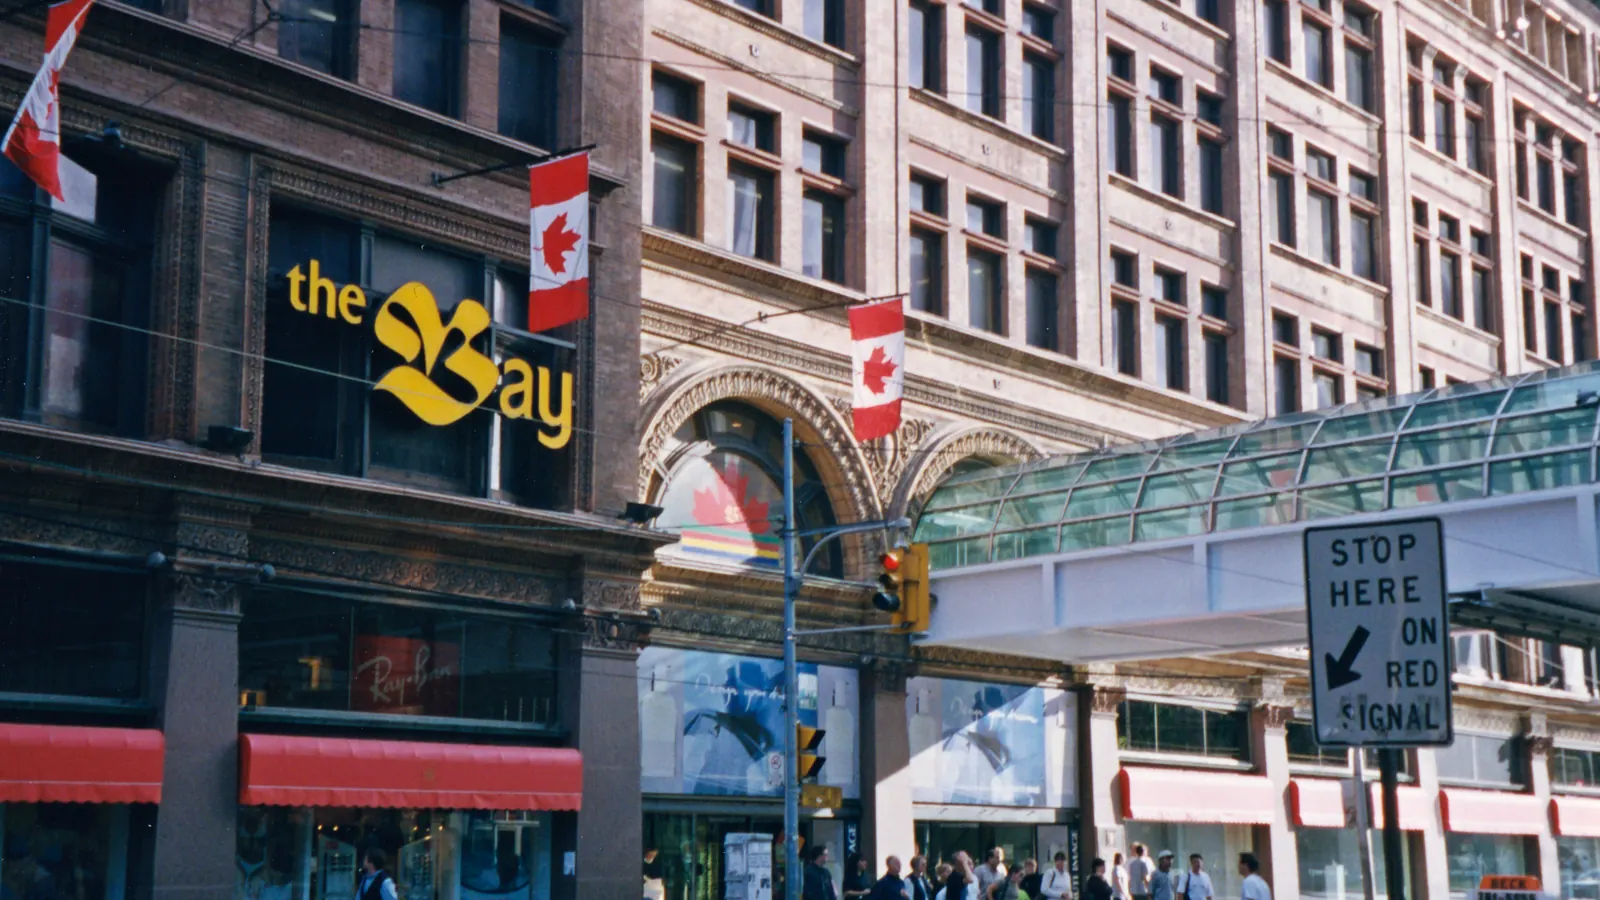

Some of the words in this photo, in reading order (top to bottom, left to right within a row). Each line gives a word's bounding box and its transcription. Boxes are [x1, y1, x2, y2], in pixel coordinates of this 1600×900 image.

[286, 259, 367, 324] the
[374, 281, 573, 449] Bay
[1331, 534, 1416, 566] STOP
[1330, 575, 1421, 607] HERE
[1402, 617, 1437, 646] ON
[1386, 660, 1438, 688] RED
[1341, 702, 1440, 731] SIGNAL
